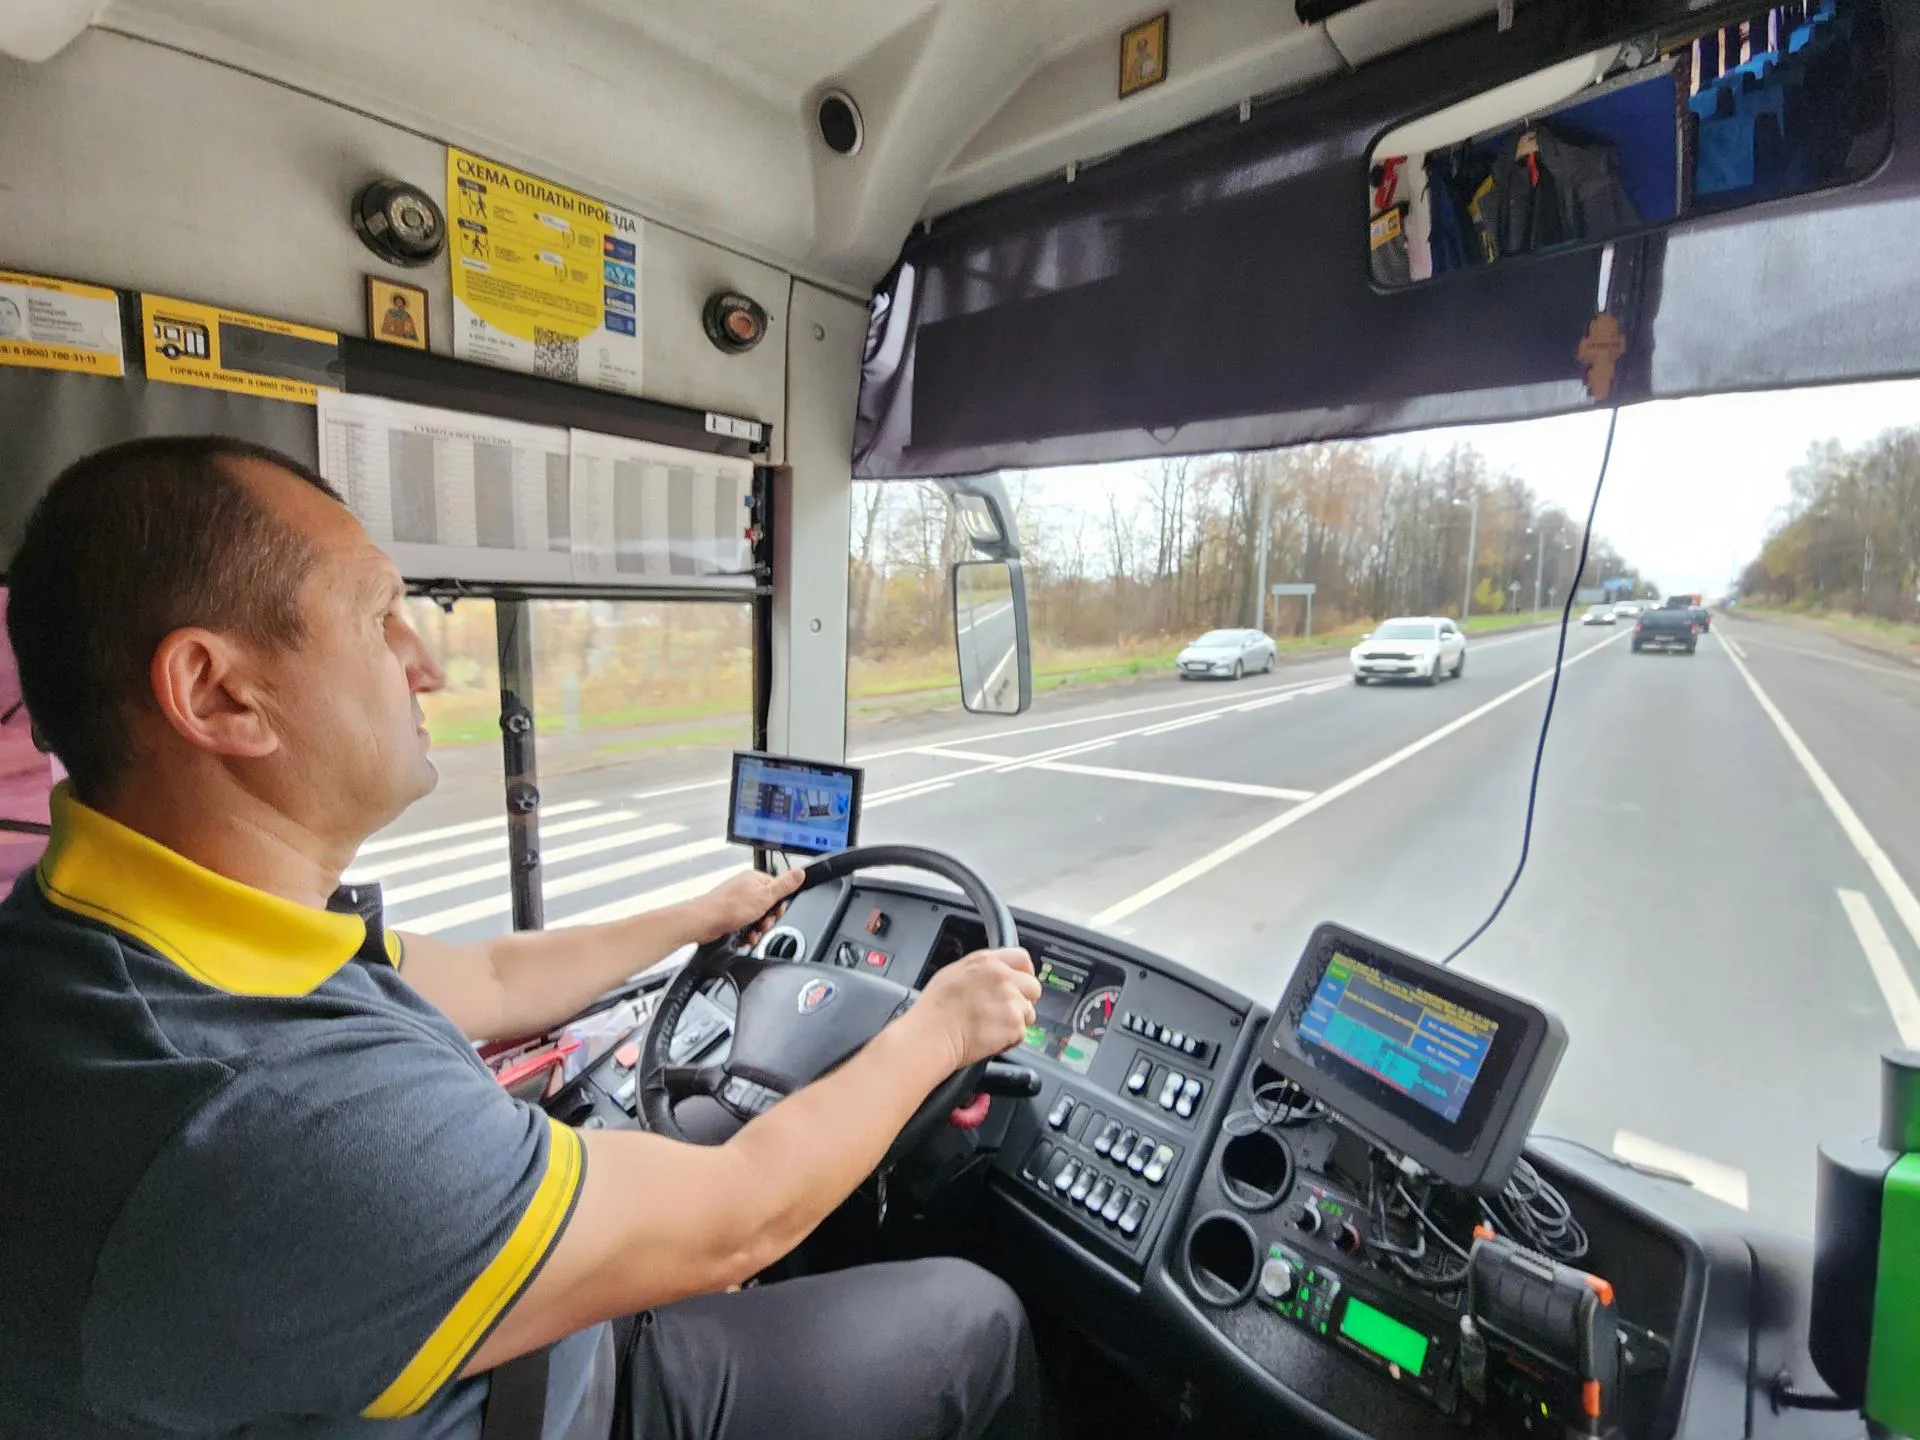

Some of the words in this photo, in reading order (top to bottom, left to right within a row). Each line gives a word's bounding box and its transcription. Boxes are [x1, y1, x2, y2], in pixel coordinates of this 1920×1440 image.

[456, 157, 510, 190] СХЕМА
[514, 178, 574, 212] ОПЛАТЫ
[578, 202, 637, 233] ПРОЕЗДА
[22, 347, 49, 359] (800)
[169, 365, 211, 380] ГОРЯЧАЯ
